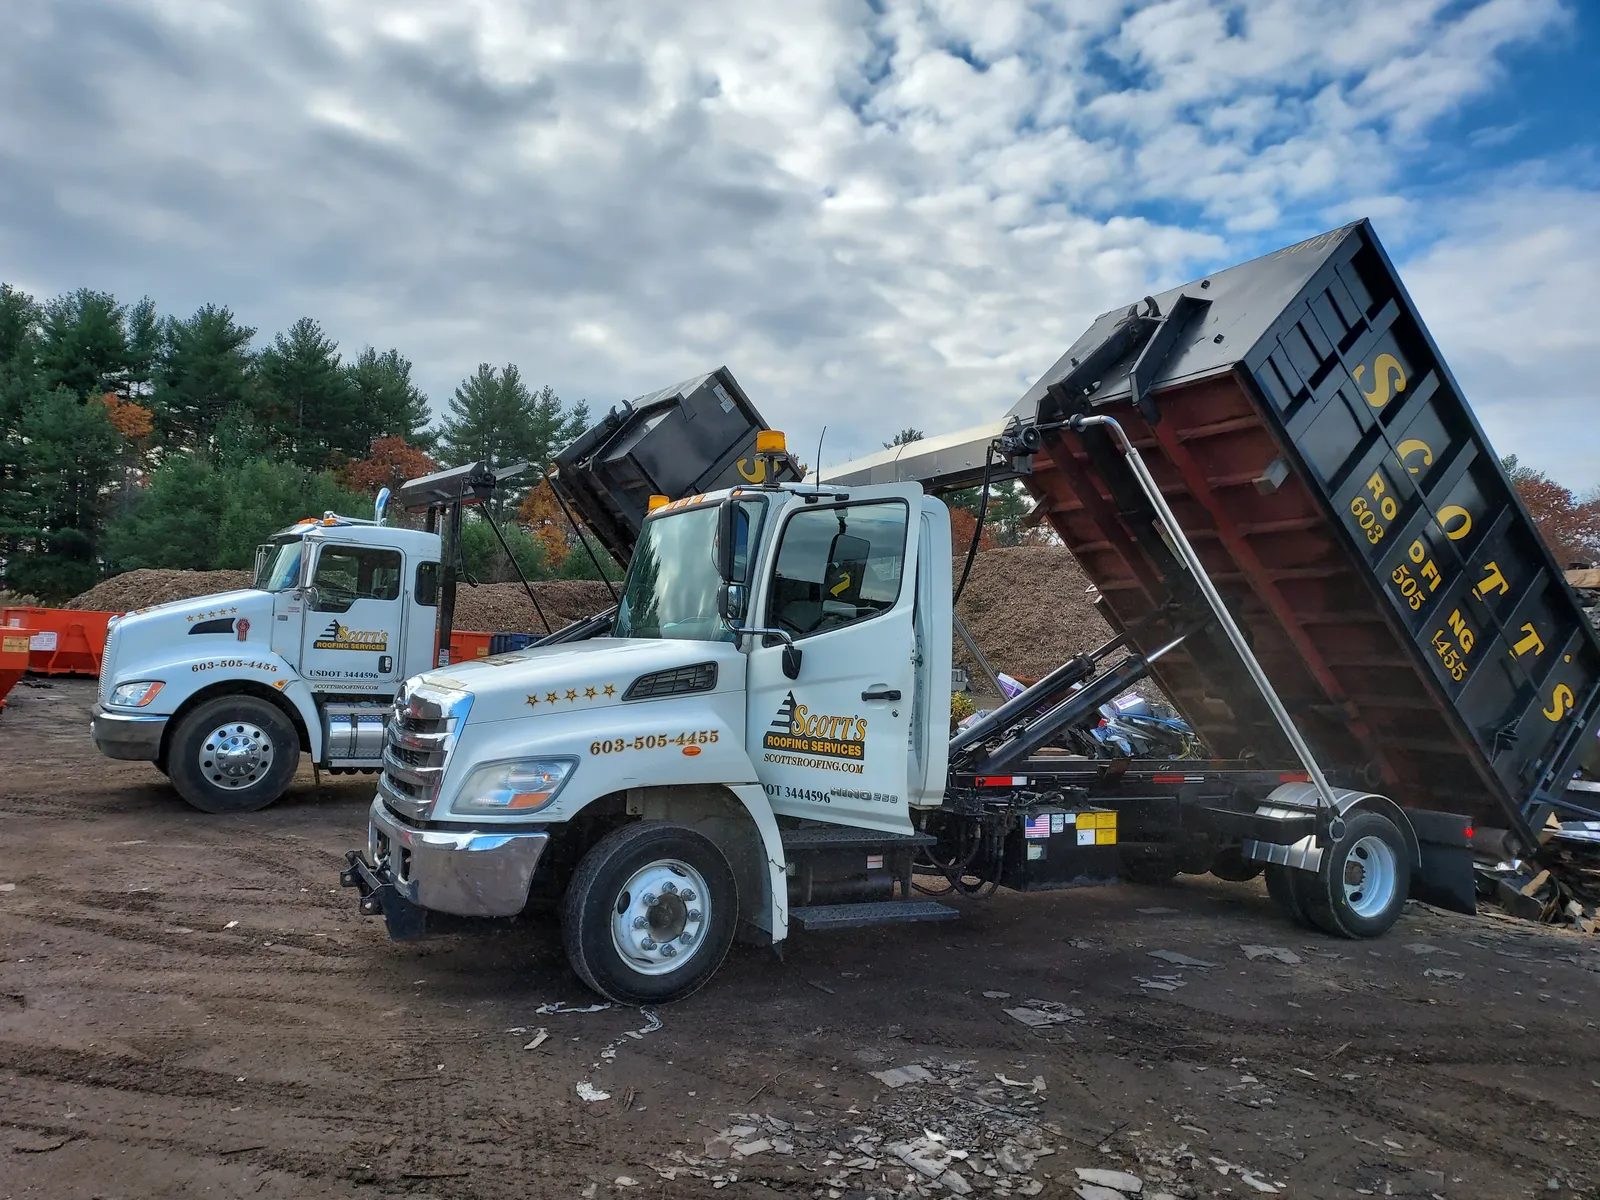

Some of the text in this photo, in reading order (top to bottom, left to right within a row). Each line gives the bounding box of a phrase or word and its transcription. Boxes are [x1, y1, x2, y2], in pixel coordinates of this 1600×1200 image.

[1353, 353, 1575, 722] SCOTT'S
[1351, 497, 1384, 544] 603
[1392, 565, 1425, 610] 505
[336, 626, 388, 643] SCOTT'S
[191, 660, 278, 672] 603-505-4455
[344, 671, 379, 679] 3444596
[791, 704, 868, 742] SCOTT'S
[590, 729, 719, 756] 603-505-4455
[767, 736, 862, 756] ROOFING SERVICES
[763, 753, 865, 774] SCOTTSROOFING.COM
[785, 786, 831, 804] 3444596
[830, 786, 872, 801] HINO
